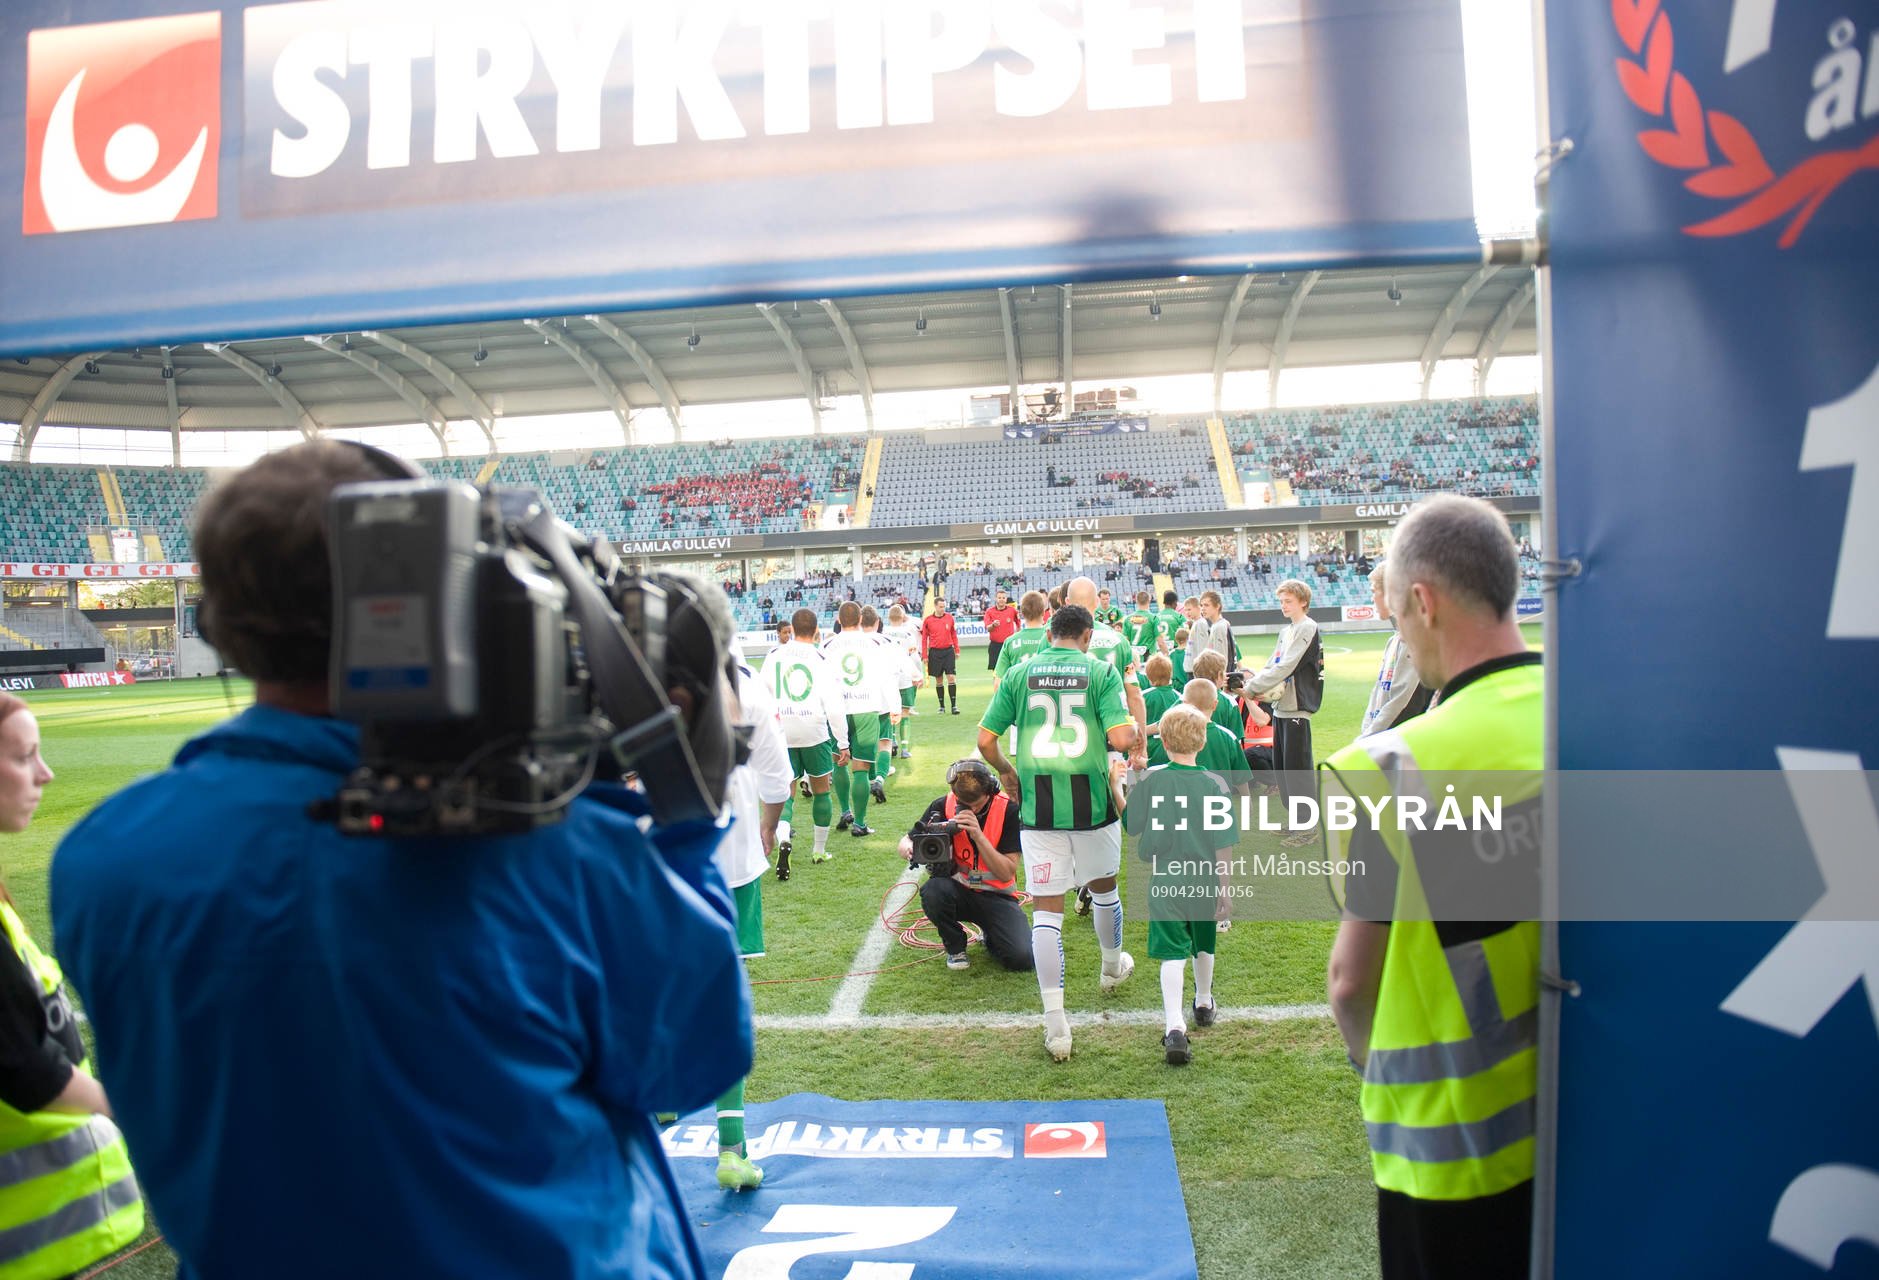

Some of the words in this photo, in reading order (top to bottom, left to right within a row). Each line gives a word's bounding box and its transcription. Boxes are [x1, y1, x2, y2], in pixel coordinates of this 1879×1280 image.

[270, 0, 1247, 178] STRYKTIPSET
[1355, 504, 1409, 518] GAMLA
[983, 522, 1036, 536] GAMLA
[1049, 519, 1100, 533] ULLEVI
[622, 542, 672, 554] GAMLA
[684, 537, 731, 551] ULLEVI
[0, 564, 17, 576] T
[32, 564, 71, 576] GT
[84, 564, 125, 577] GT
[139, 564, 179, 576] GT
[955, 623, 988, 635] ötebor
[1131, 624, 1143, 646] 7
[841, 653, 864, 687] 9
[65, 671, 110, 688] MATCH
[775, 661, 814, 702] 10
[1066, 678, 1078, 687] AB
[1028, 693, 1088, 758] 25
[660, 1120, 1005, 1154] STRYKTIPET
